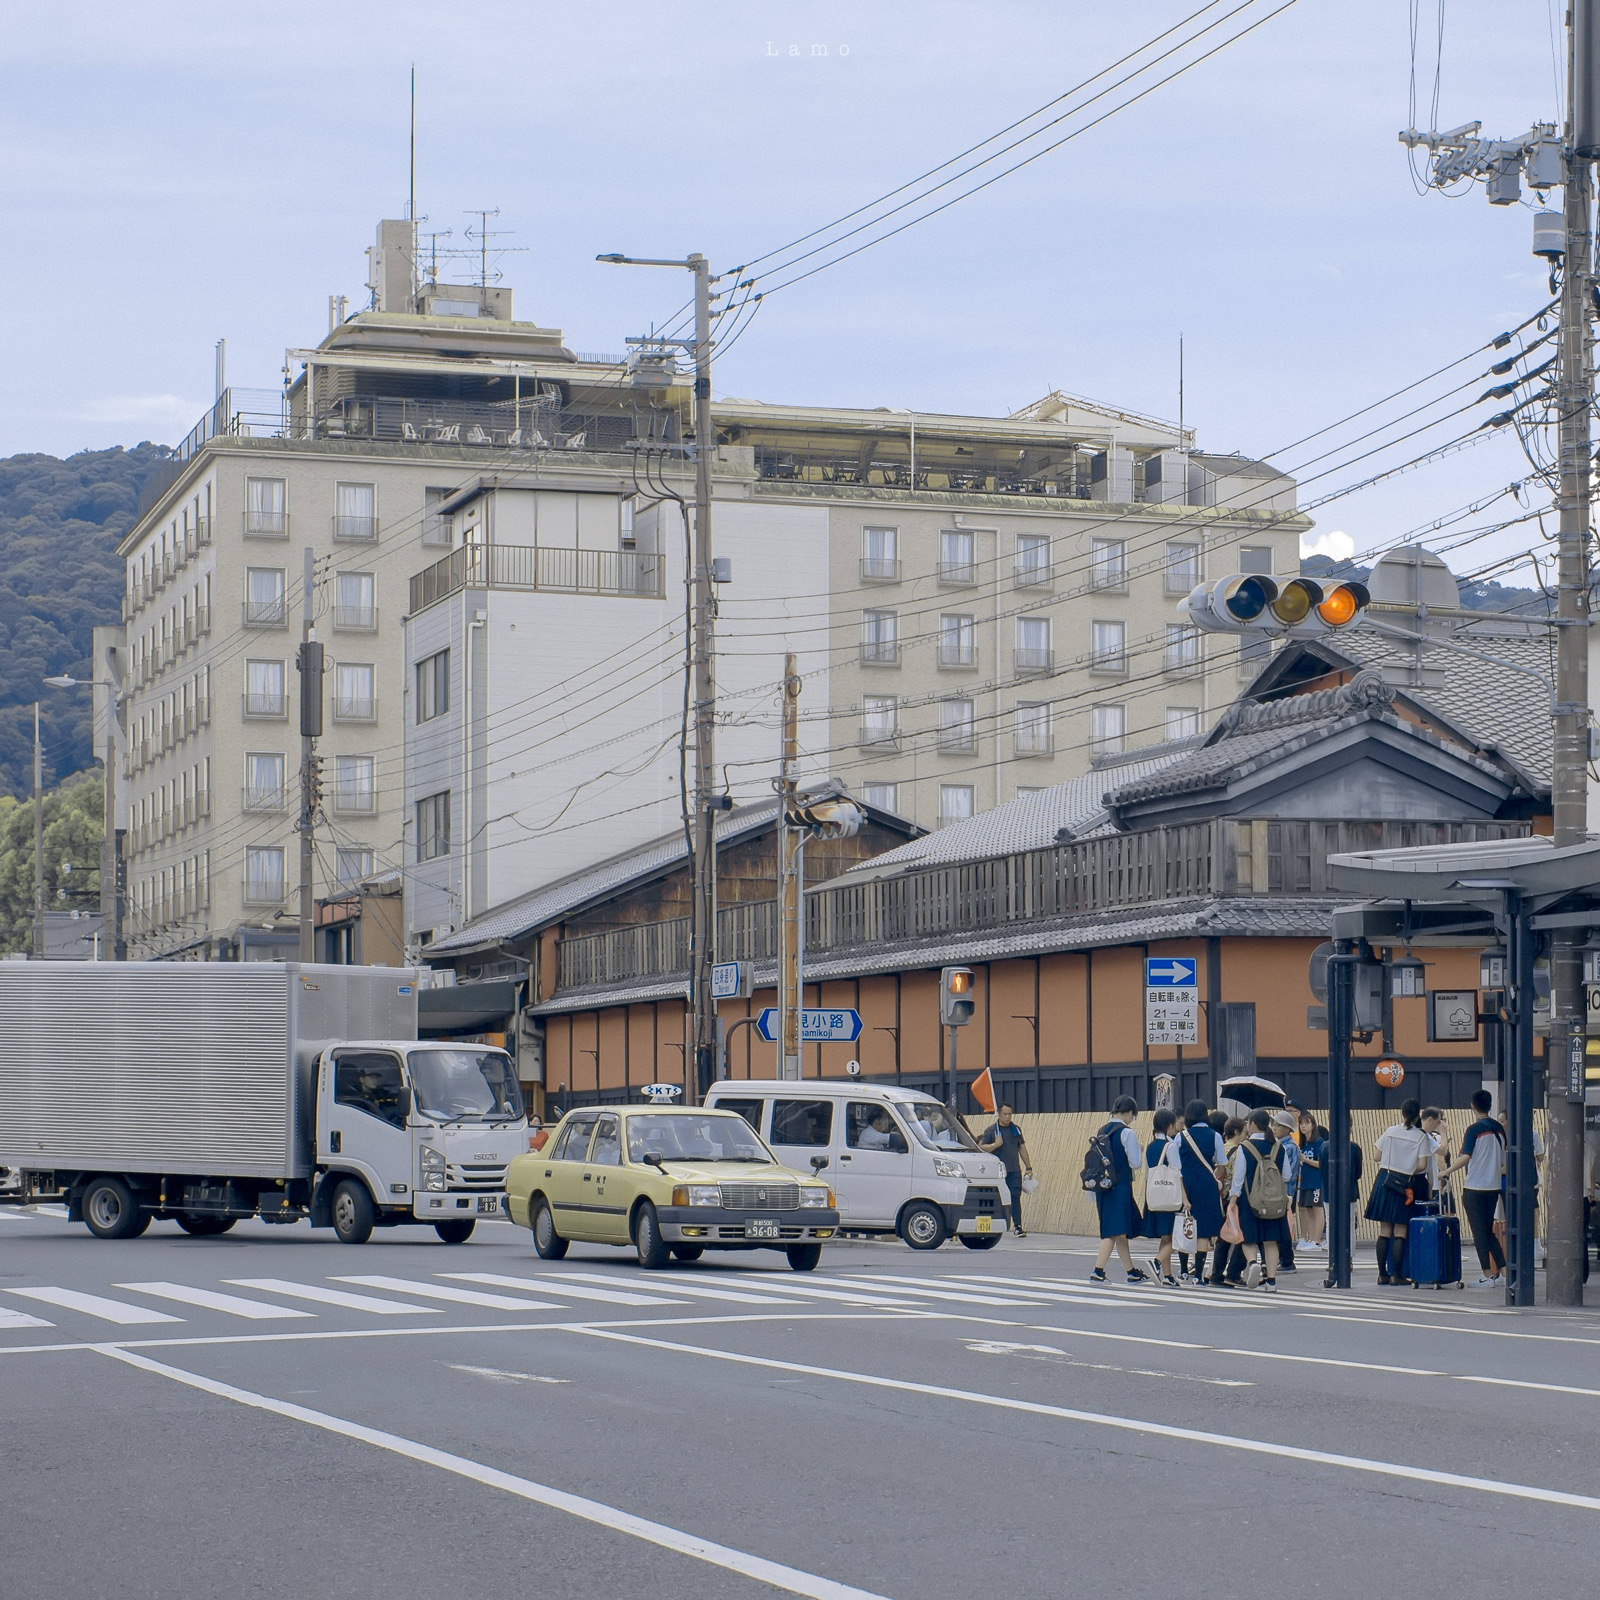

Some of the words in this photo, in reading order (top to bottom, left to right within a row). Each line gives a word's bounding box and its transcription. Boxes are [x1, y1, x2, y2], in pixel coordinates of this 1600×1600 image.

[1149, 992, 1195, 1002] 自転車を除く
